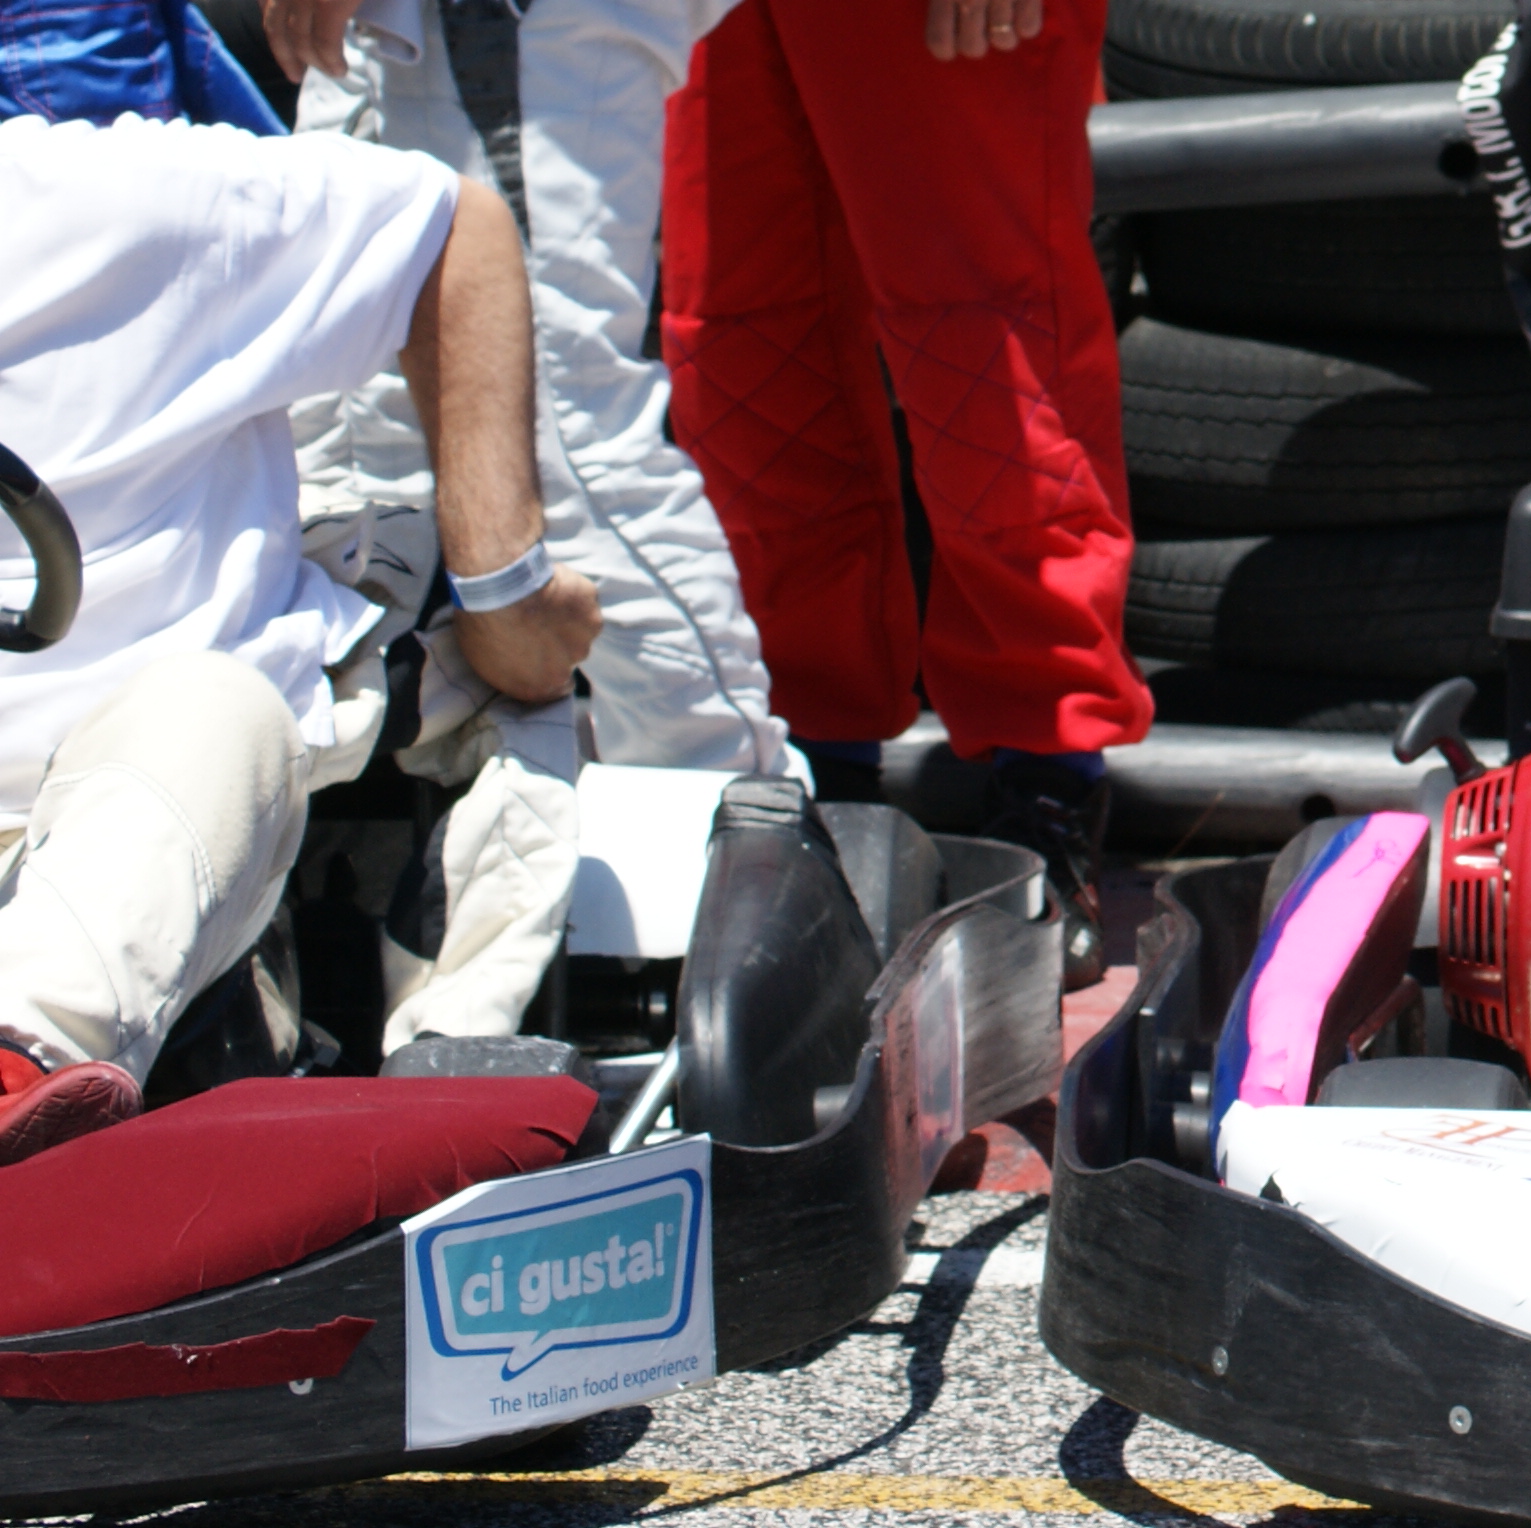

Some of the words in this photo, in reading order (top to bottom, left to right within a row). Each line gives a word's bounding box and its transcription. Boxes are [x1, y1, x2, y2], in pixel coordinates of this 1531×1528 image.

[460, 1254, 504, 1317] ci
[518, 1221, 666, 1316] gusta!
[489, 1396, 523, 1417] The
[526, 1387, 579, 1410] Italian
[582, 1371, 619, 1398] food
[622, 1353, 700, 1389] experience
